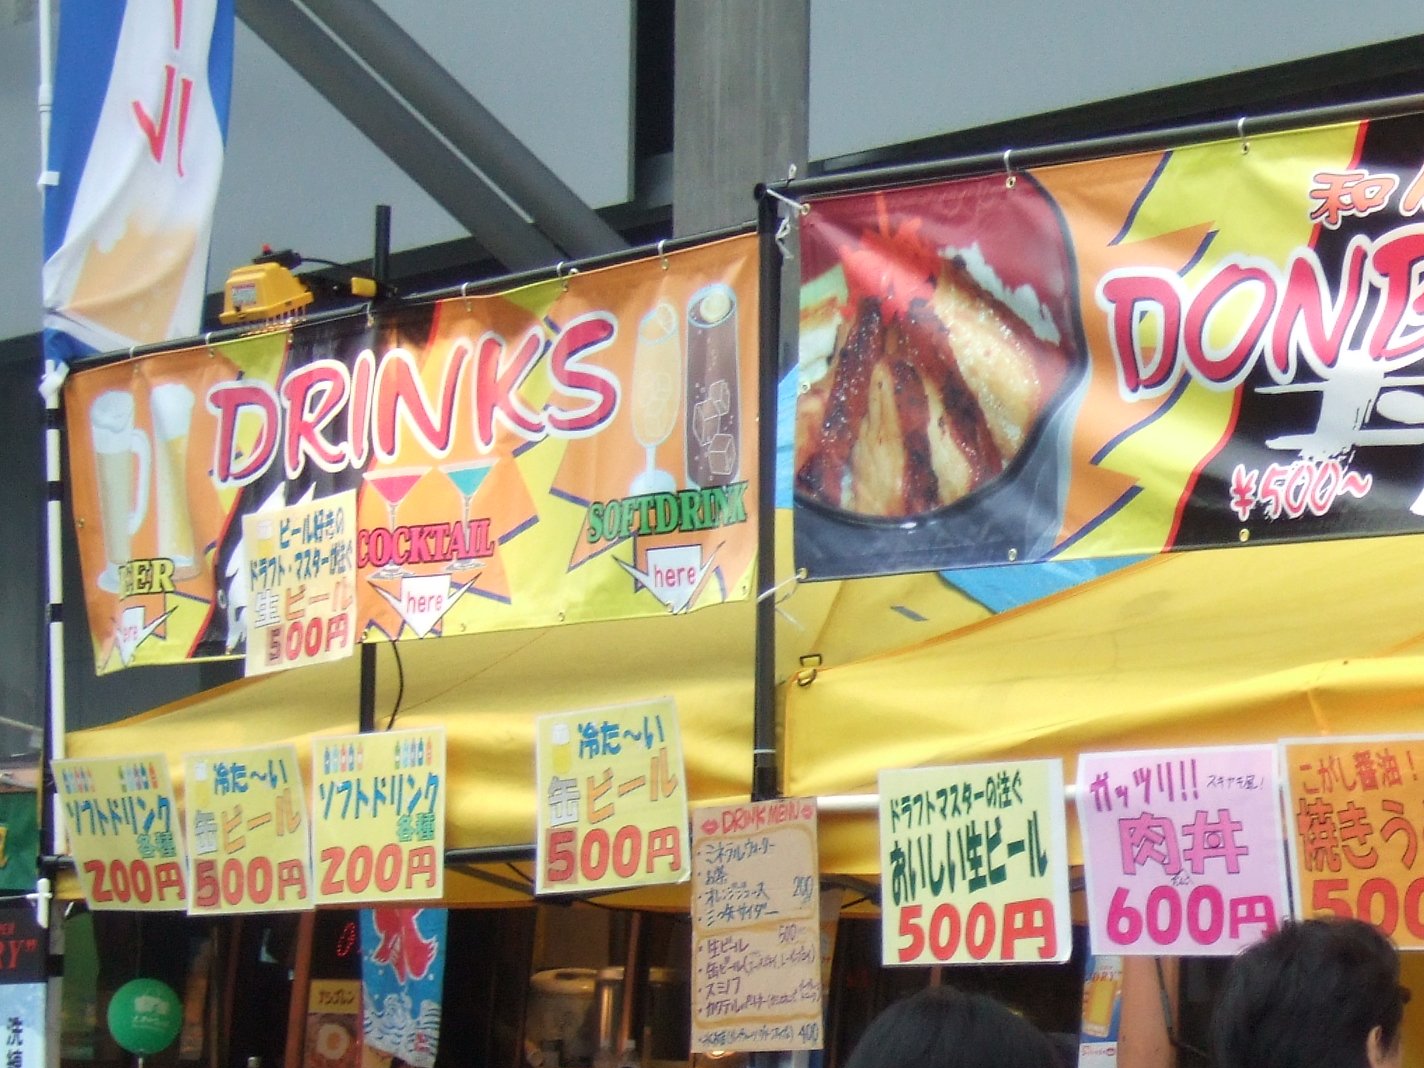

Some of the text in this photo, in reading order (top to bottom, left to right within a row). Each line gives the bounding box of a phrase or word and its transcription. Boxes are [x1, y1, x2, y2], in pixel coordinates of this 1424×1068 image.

[206, 311, 620, 486] DRINKS
[587, 480, 749, 543] SOFTDRINK
[357, 517, 495, 568] COCKTAIL
[254, 576, 353, 629] 生ビール
[406, 591, 442, 615] here
[654, 564, 697, 588] here
[65, 794, 172, 836] ソフトドリンク
[318, 772, 440, 821] ソフトドリンク
[547, 746, 678, 828] 缶ビール
[889, 769, 1023, 833] ドラフトマスターの注ぐ
[194, 788, 300, 856] 缶ビール
[396, 812, 436, 842] 各種
[1118, 808, 1249, 876] 肉丼
[83, 857, 185, 903] 200円
[320, 843, 437, 896] 200円
[546, 823, 682, 884] 500円
[889, 809, 1048, 906] おいしい生ビール
[195, 856, 306, 909] 500円
[898, 897, 1057, 962] 500円
[1106, 884, 1280, 946] 600円
